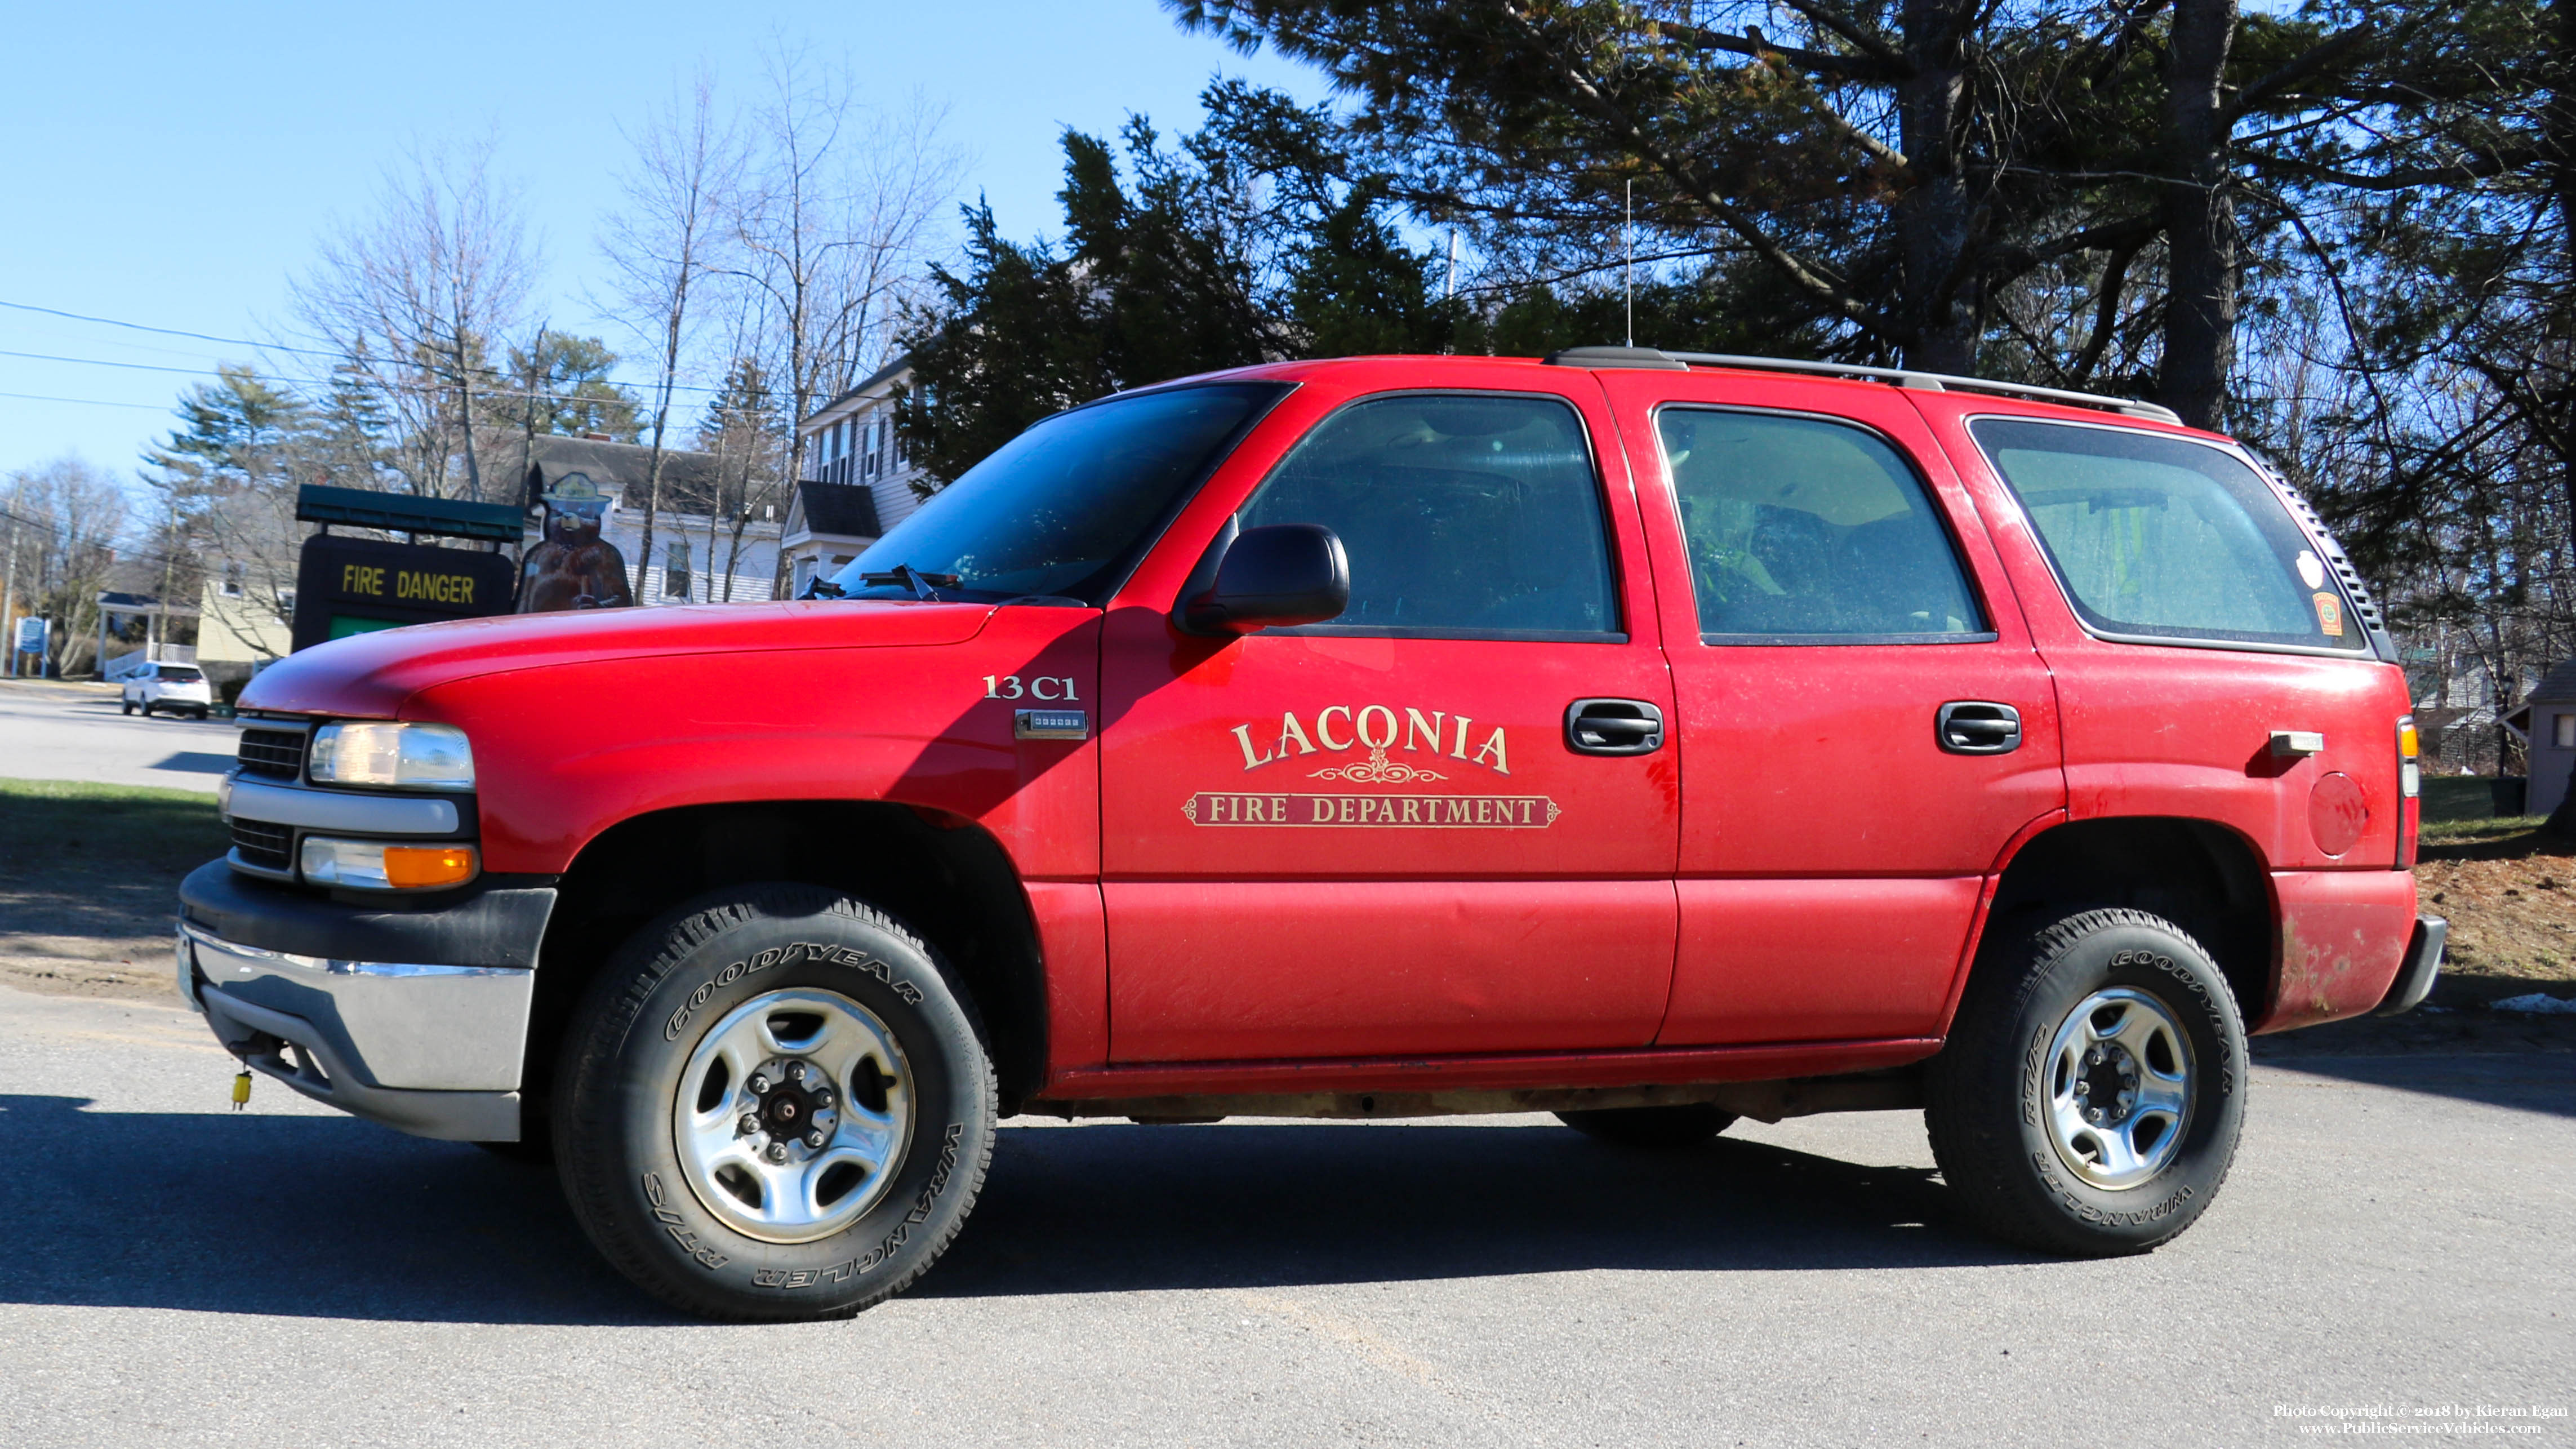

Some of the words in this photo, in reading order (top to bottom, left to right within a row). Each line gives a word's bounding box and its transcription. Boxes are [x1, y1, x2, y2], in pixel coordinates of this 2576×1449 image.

[342, 565, 384, 595] FIRE
[397, 570, 474, 604] DANGER
[1231, 704, 1511, 775] LACONIA
[1209, 796, 1288, 823] FIRE
[1311, 797, 1537, 824] DEPARTMENT
[664, 942, 925, 1042] GOODYEAR
[2111, 949, 2235, 1096] GOODYEAR
[752, 1123, 963, 1290] WRANGLER
[2032, 1149, 2194, 1227] WRANGLER
